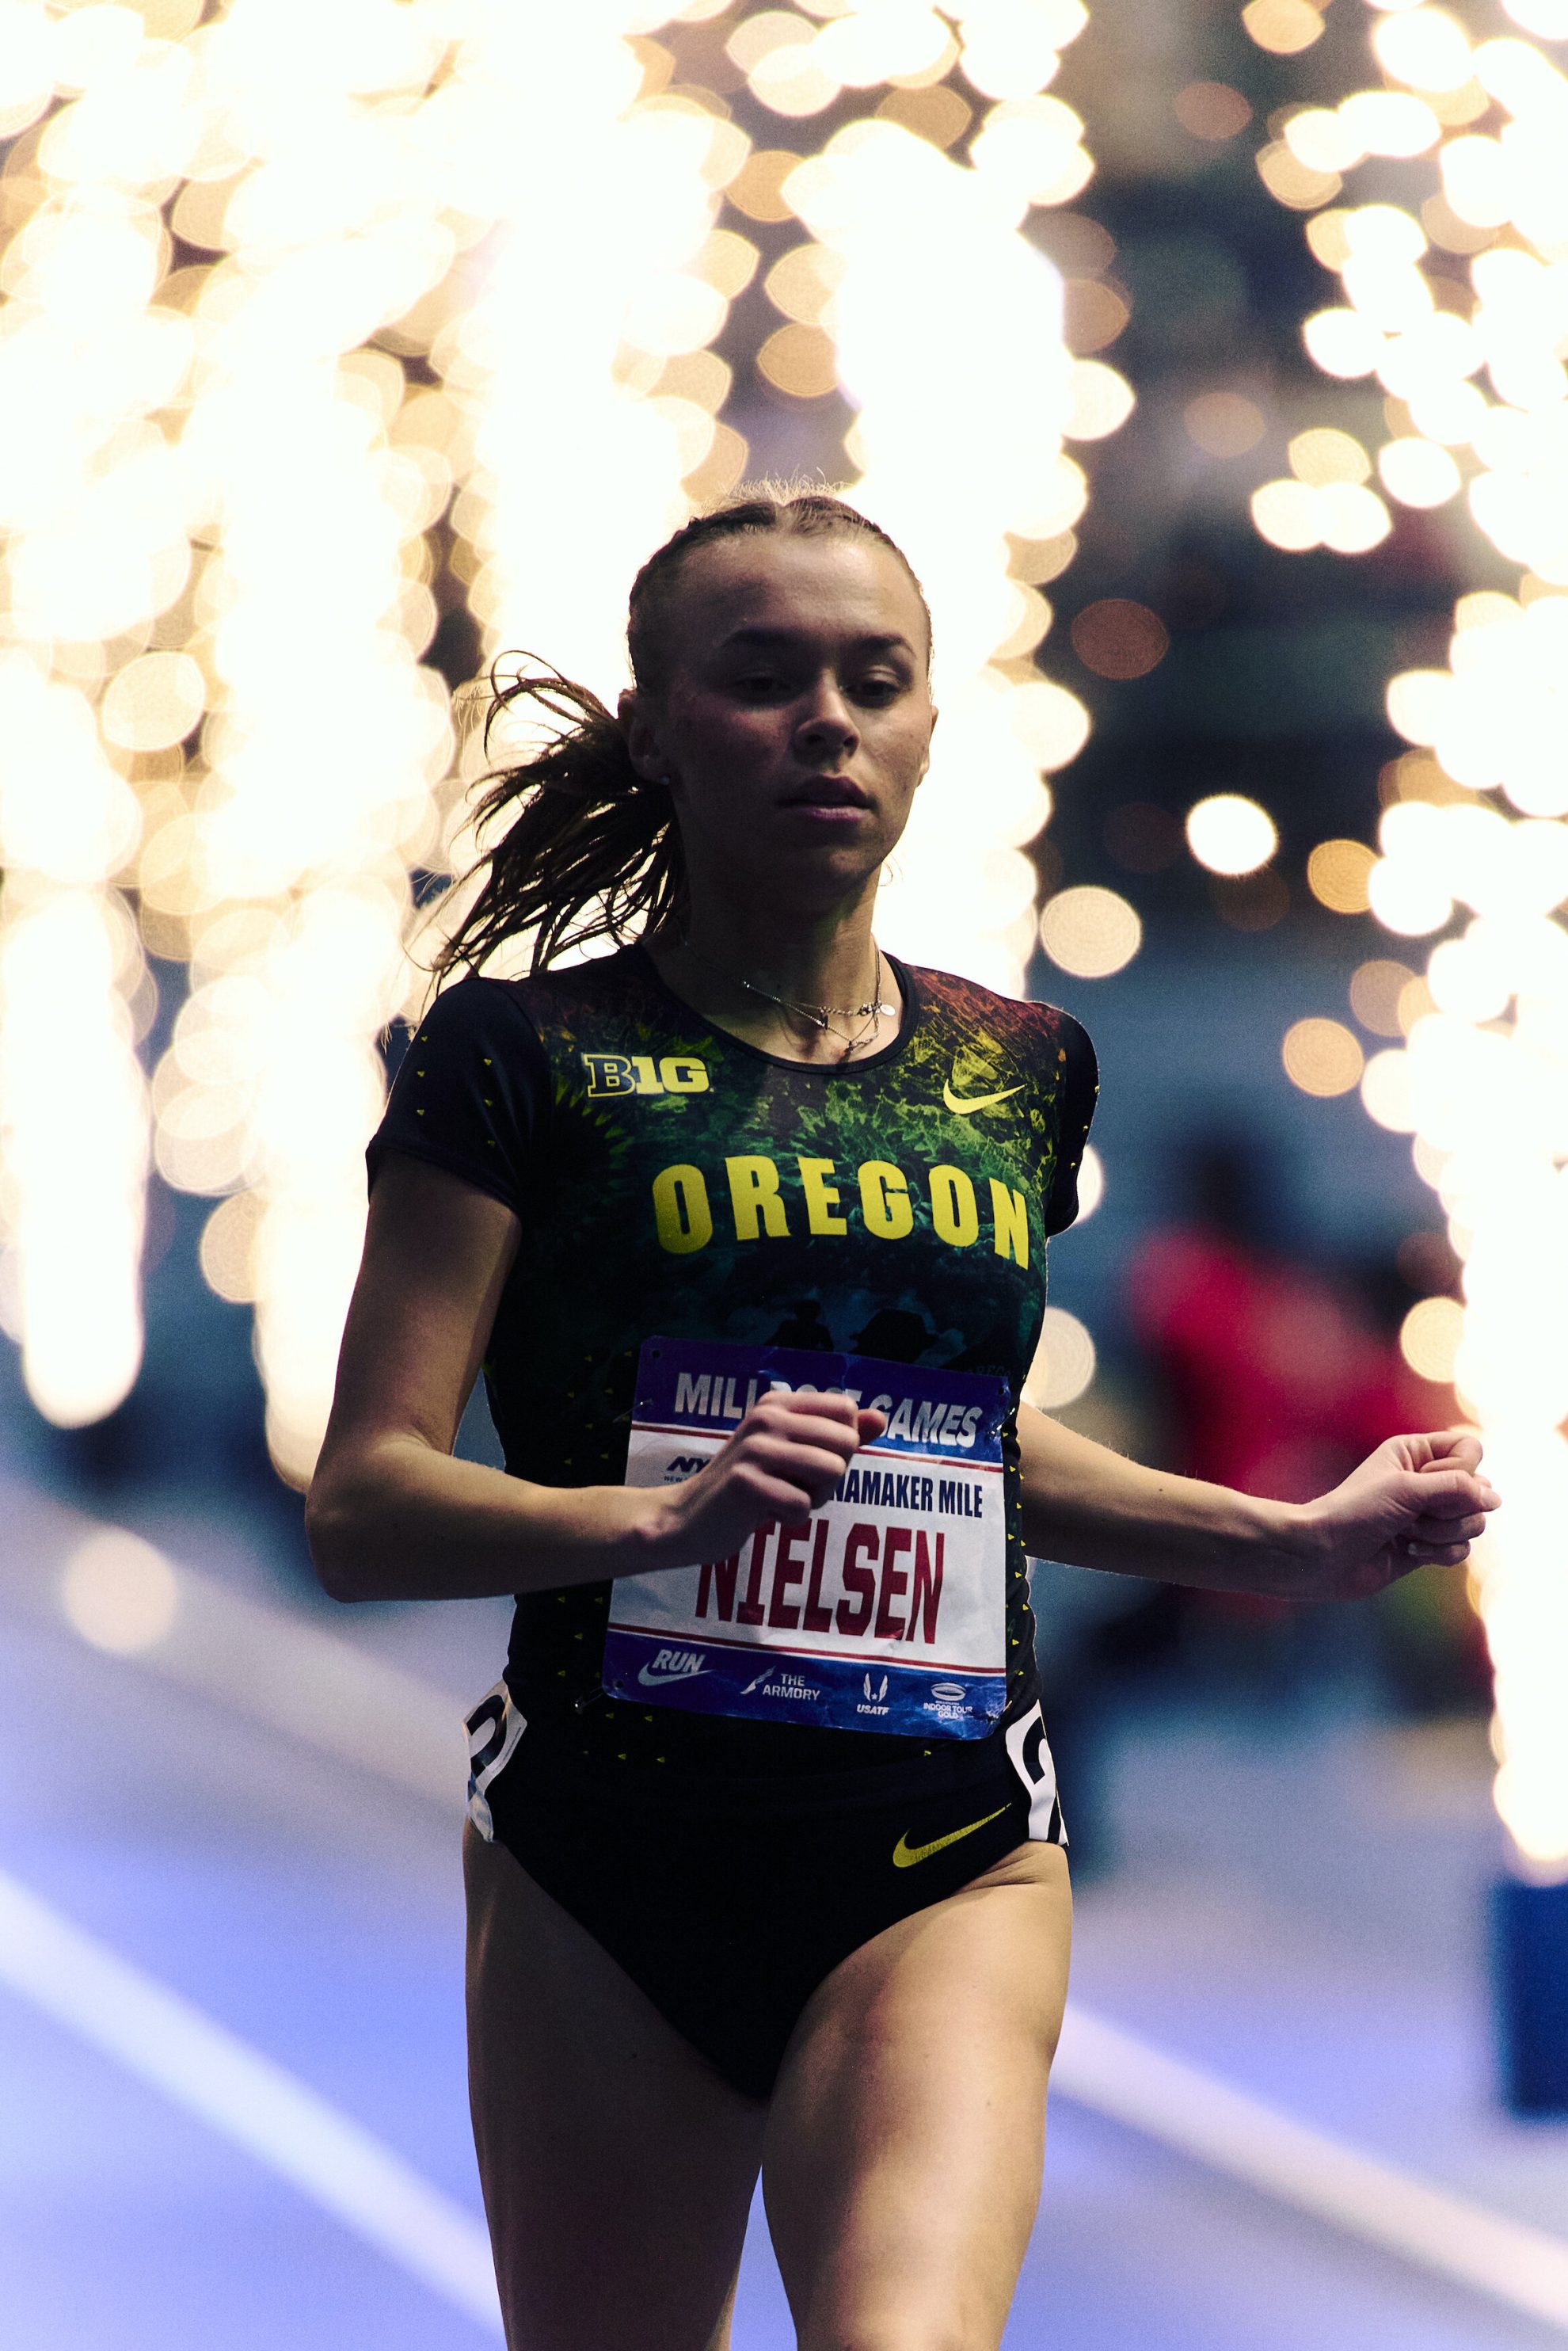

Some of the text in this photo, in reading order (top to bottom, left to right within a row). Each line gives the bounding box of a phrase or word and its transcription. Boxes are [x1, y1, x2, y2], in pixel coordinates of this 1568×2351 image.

[653, 1155, 1029, 1270] OREGON
[674, 1373, 984, 1449] MILL GAMES
[831, 1469, 982, 1518] NAMAKER MILE
[695, 1518, 945, 1644] NIELSEN
[652, 1649, 706, 1674] RUN
[781, 1673, 805, 1686] THE
[762, 1684, 820, 1701] ARMORY
[857, 1704, 890, 1716] USATF
[923, 1702, 951, 1713] INDOOR
[953, 1705, 973, 1714] TOUR
[938, 1711, 959, 1720] GOLD
